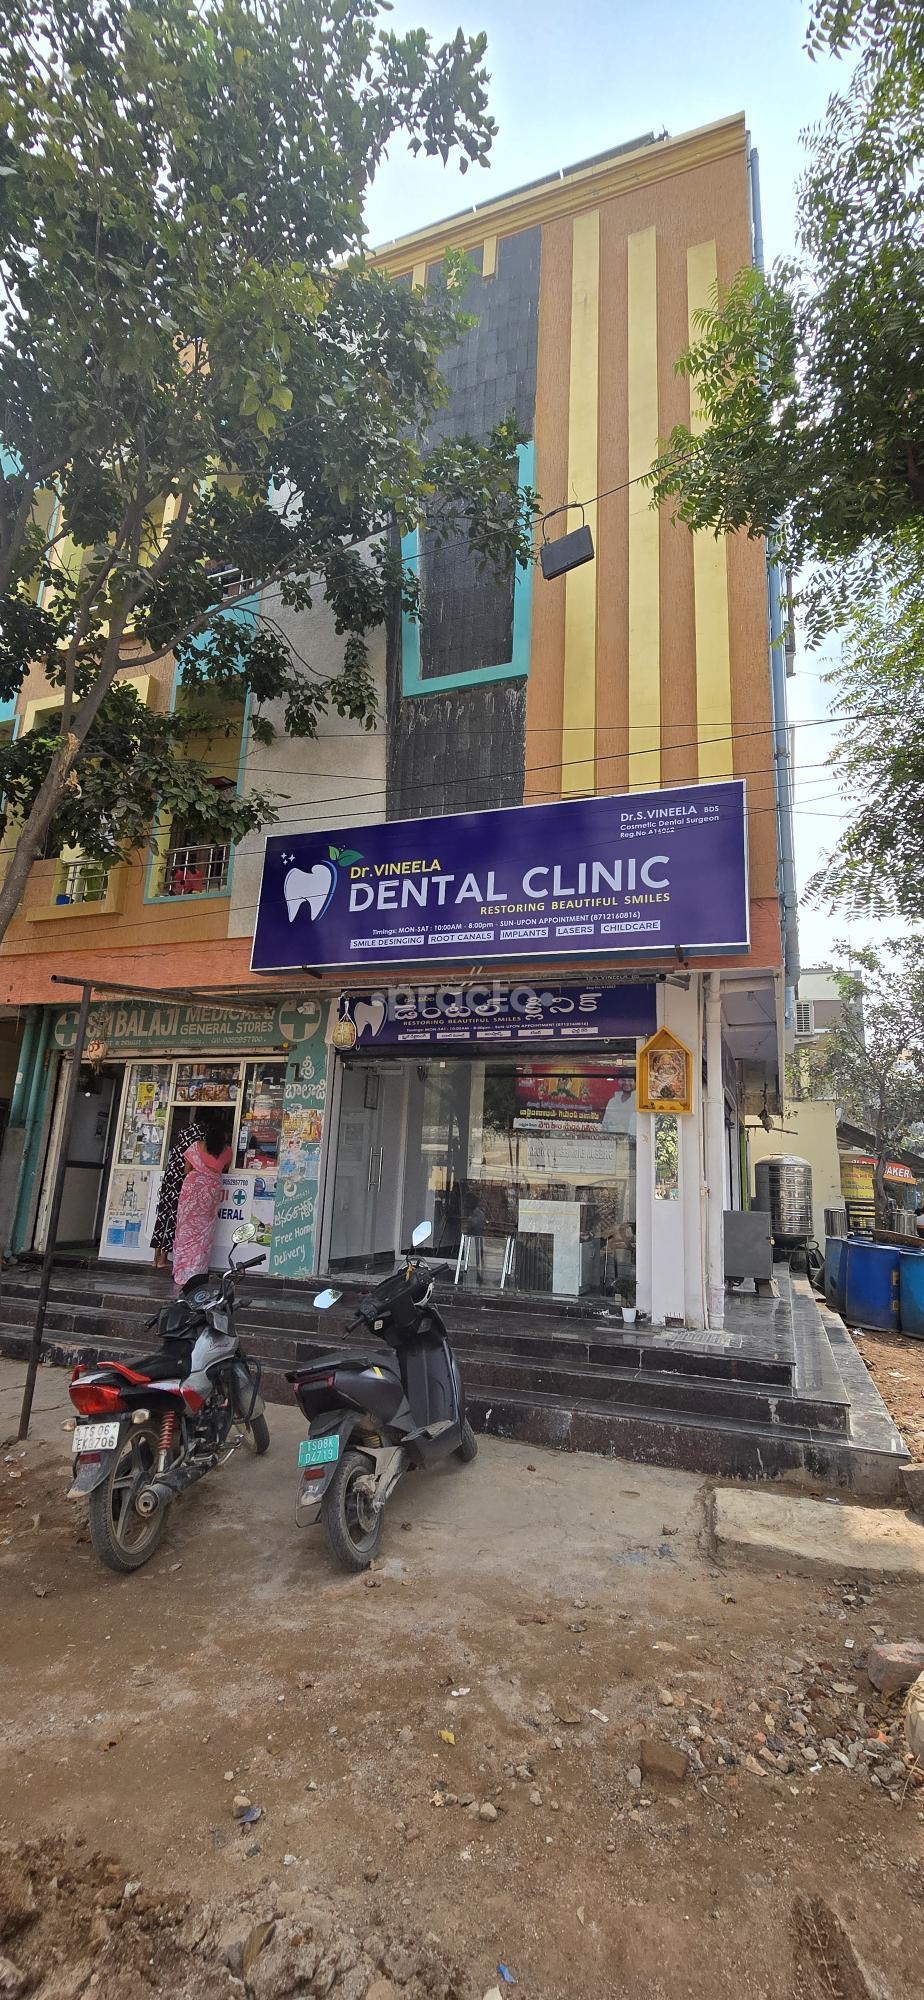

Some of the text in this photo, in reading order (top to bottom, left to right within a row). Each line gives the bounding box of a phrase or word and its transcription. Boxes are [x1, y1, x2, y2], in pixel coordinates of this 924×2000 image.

[620, 805, 720, 822] Dr.S.VINEELA BDS
[620, 815, 720, 831] Cosmetic Dental Surgeon
[350, 859, 442, 879] Dr.VINEELA
[349, 855, 670, 912] DENTAL CLINIC
[480, 893, 671, 915] RESTORING BEAUTIFUL SMILES
[468, 922, 494, 930] 8:00pm
[538, 914, 589, 925] APPOINTMENT
[353, 922, 659, 947] SMILE DESINGING ROOT CANALS IMPLANTS LASERS CHILDCARE
[114, 1008, 180, 1037] BALAJI
[180, 1021, 274, 1035] GENERAL STORES
[885, 1166, 913, 1179] AKER
[275, 1232, 293, 1247] Free
[274, 1243, 306, 1266] Delivery
[98, 1425, 110, 1436] 06
